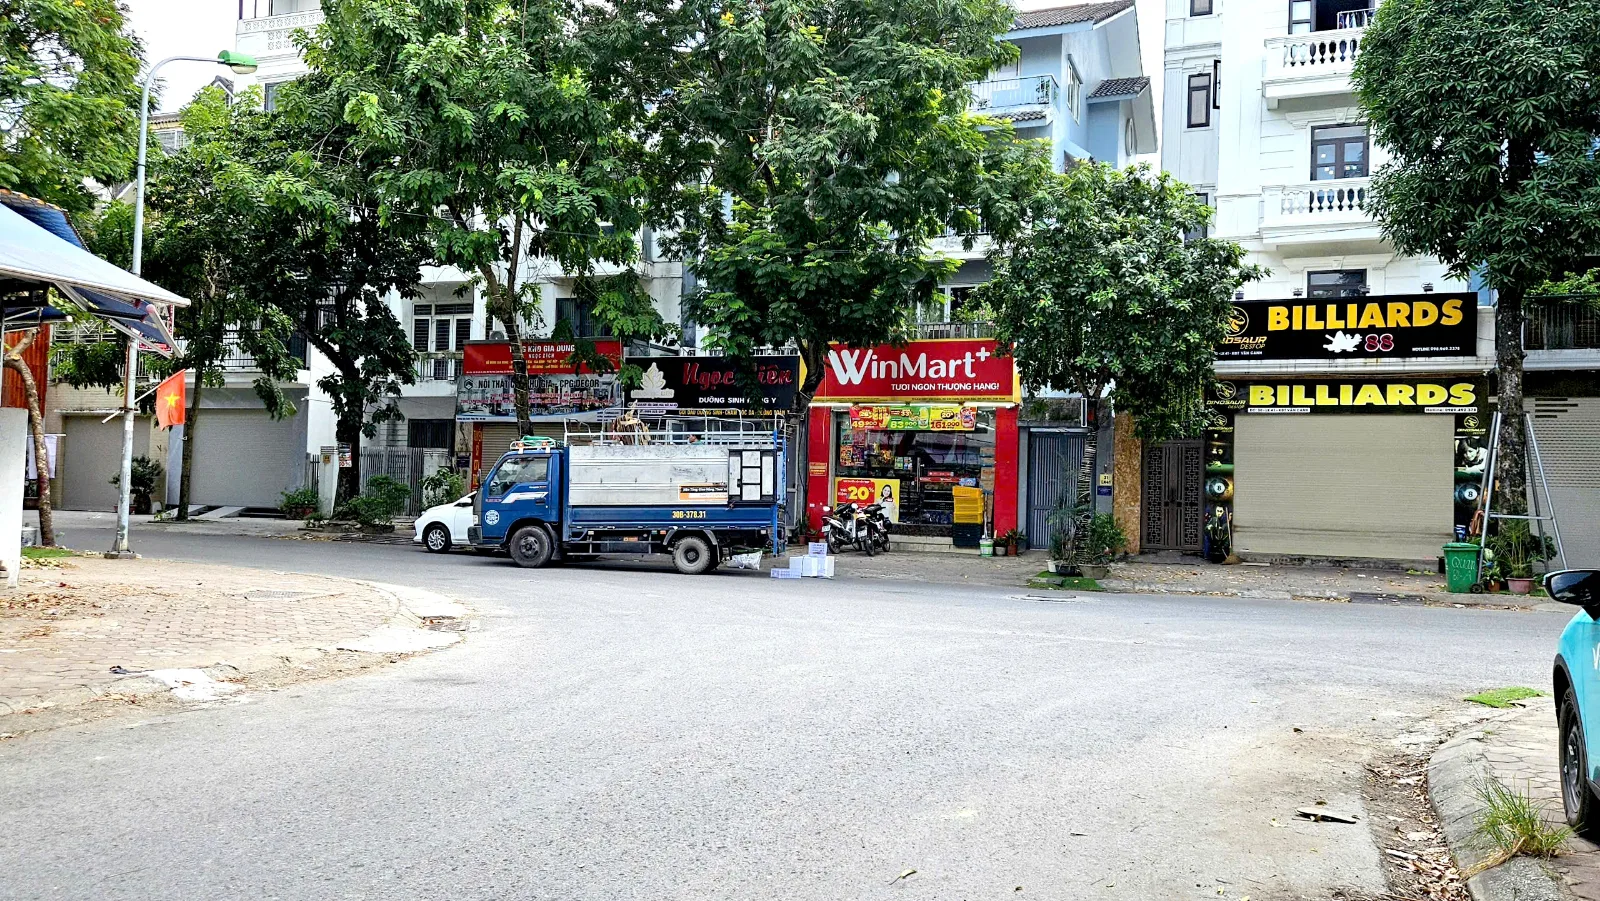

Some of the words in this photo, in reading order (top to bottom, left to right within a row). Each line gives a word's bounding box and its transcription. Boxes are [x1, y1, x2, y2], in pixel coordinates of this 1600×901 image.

[1268, 298, 1464, 332] BILLIARDS
[543, 345, 555, 353] GIA
[1364, 333, 1394, 352] 88
[559, 379, 574, 389] CPG
[575, 379, 600, 389] DECOR
[682, 362, 735, 391] Ngọc
[755, 364, 793, 385] iên
[698, 395, 725, 404] DƯỠNG
[1249, 383, 1476, 406] BILLIARDS
